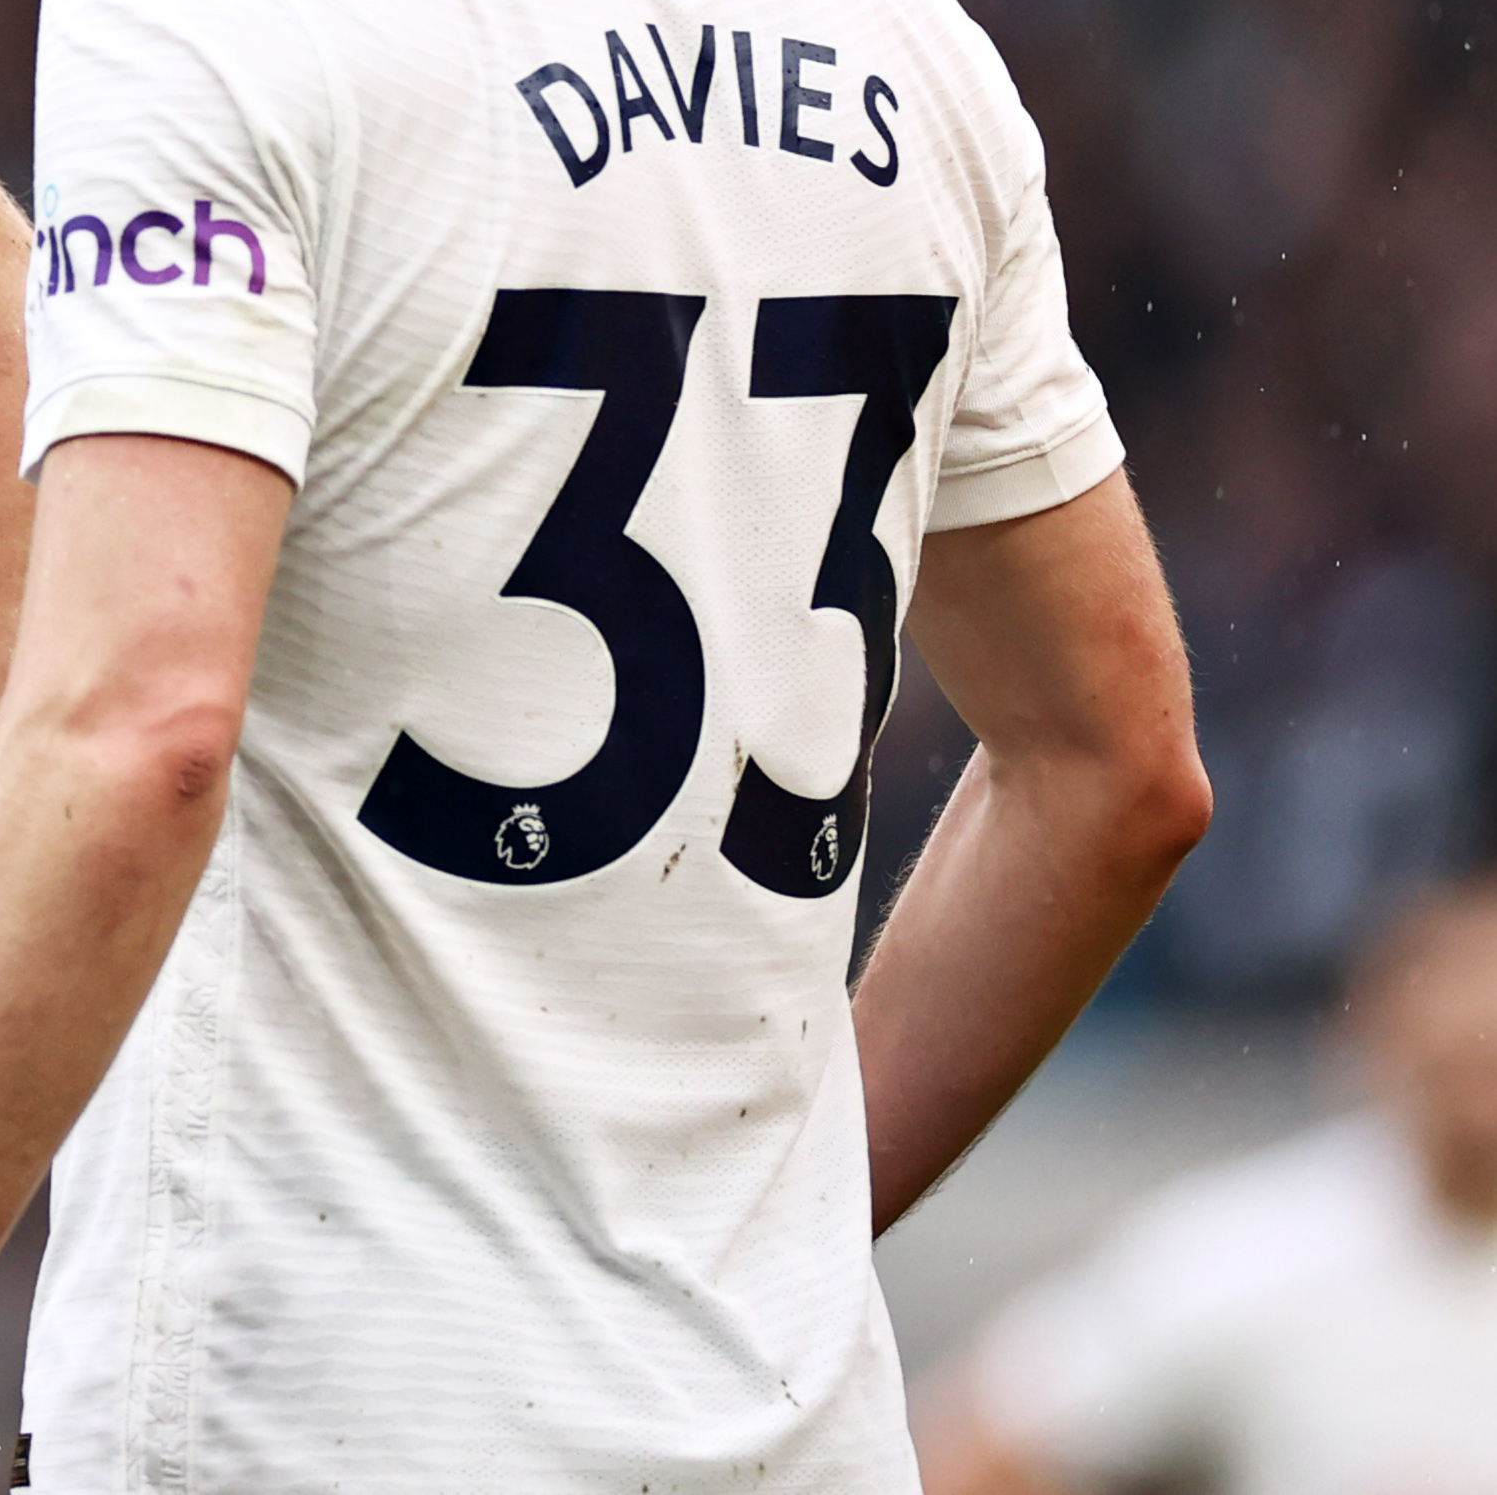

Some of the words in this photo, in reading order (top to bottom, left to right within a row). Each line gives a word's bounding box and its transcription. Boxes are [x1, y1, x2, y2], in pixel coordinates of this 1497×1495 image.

[516, 24, 899, 188] DAVIES
[37, 183, 266, 296] inch
[357, 288, 959, 900] 33
